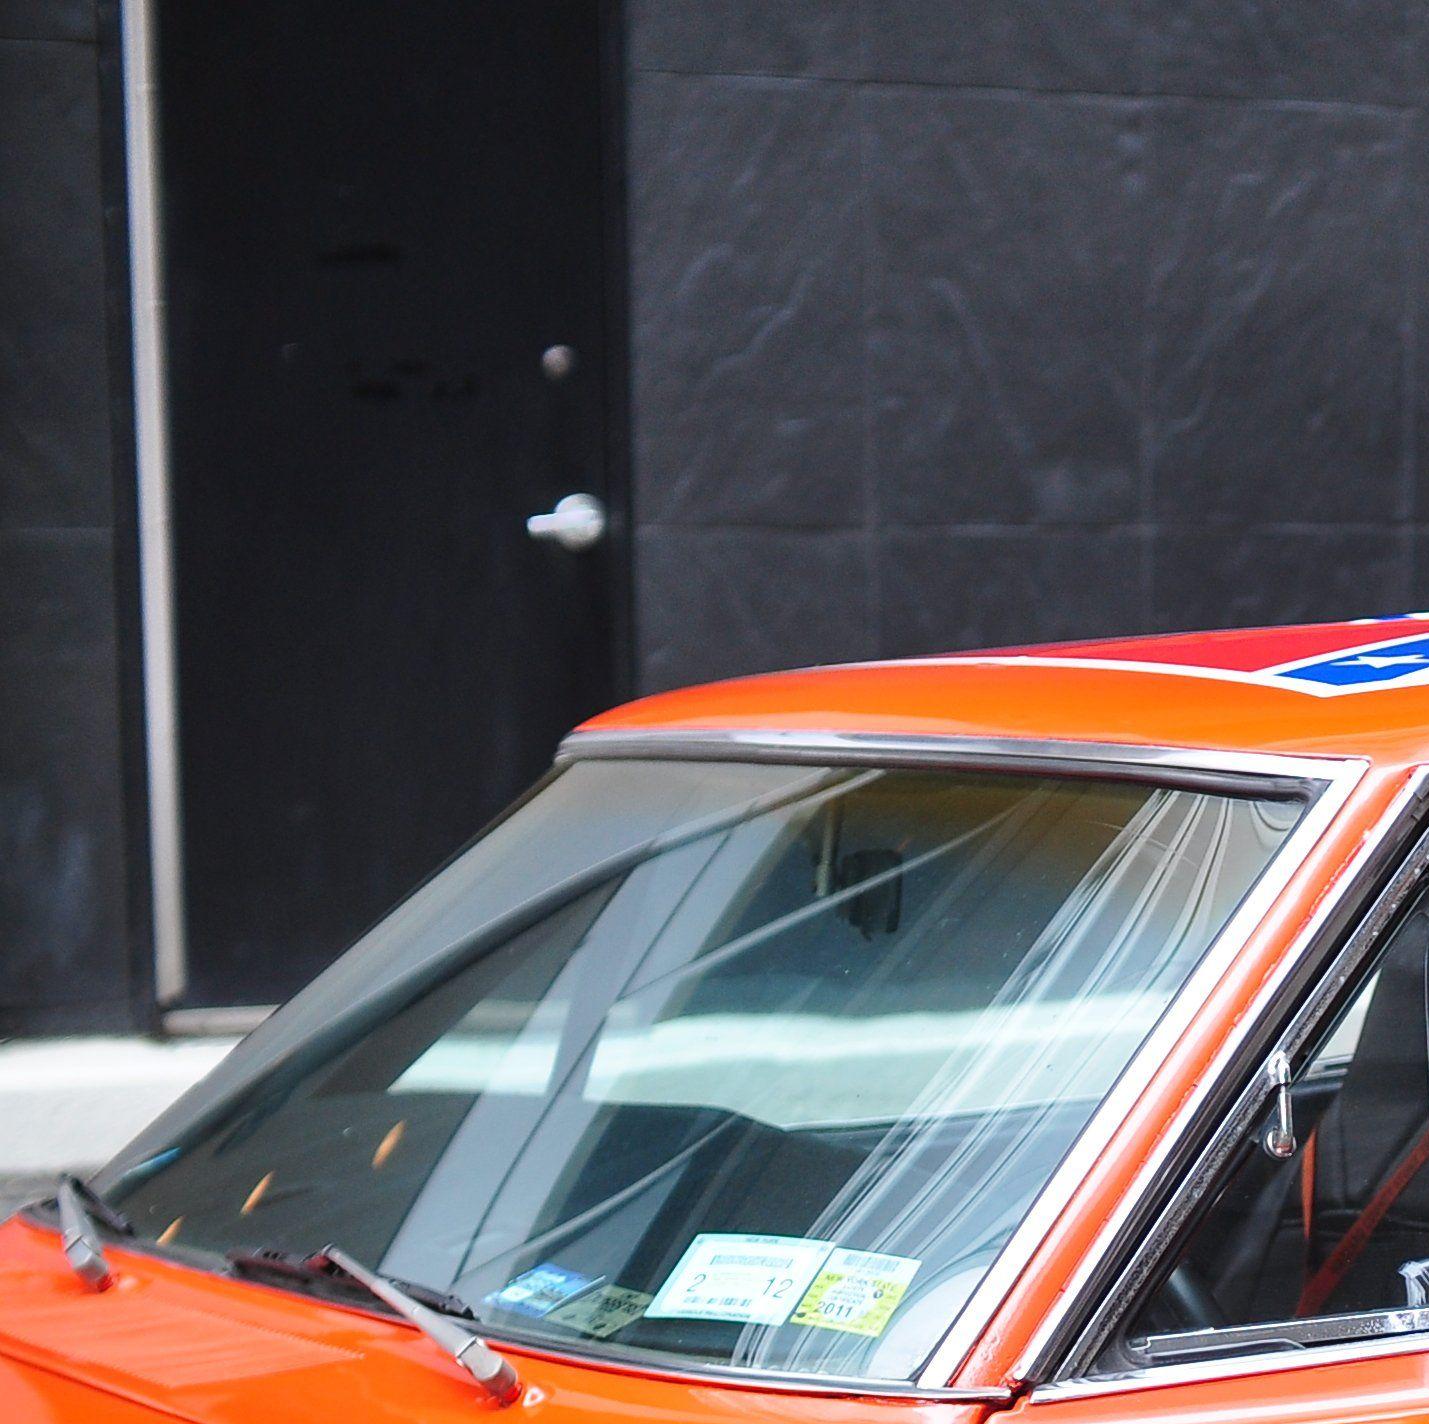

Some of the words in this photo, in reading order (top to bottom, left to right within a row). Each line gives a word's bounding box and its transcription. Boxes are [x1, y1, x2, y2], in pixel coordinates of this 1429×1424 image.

[686, 1273, 707, 1293] 2
[763, 1276, 794, 1299] 12
[814, 1301, 854, 1319] 2011
